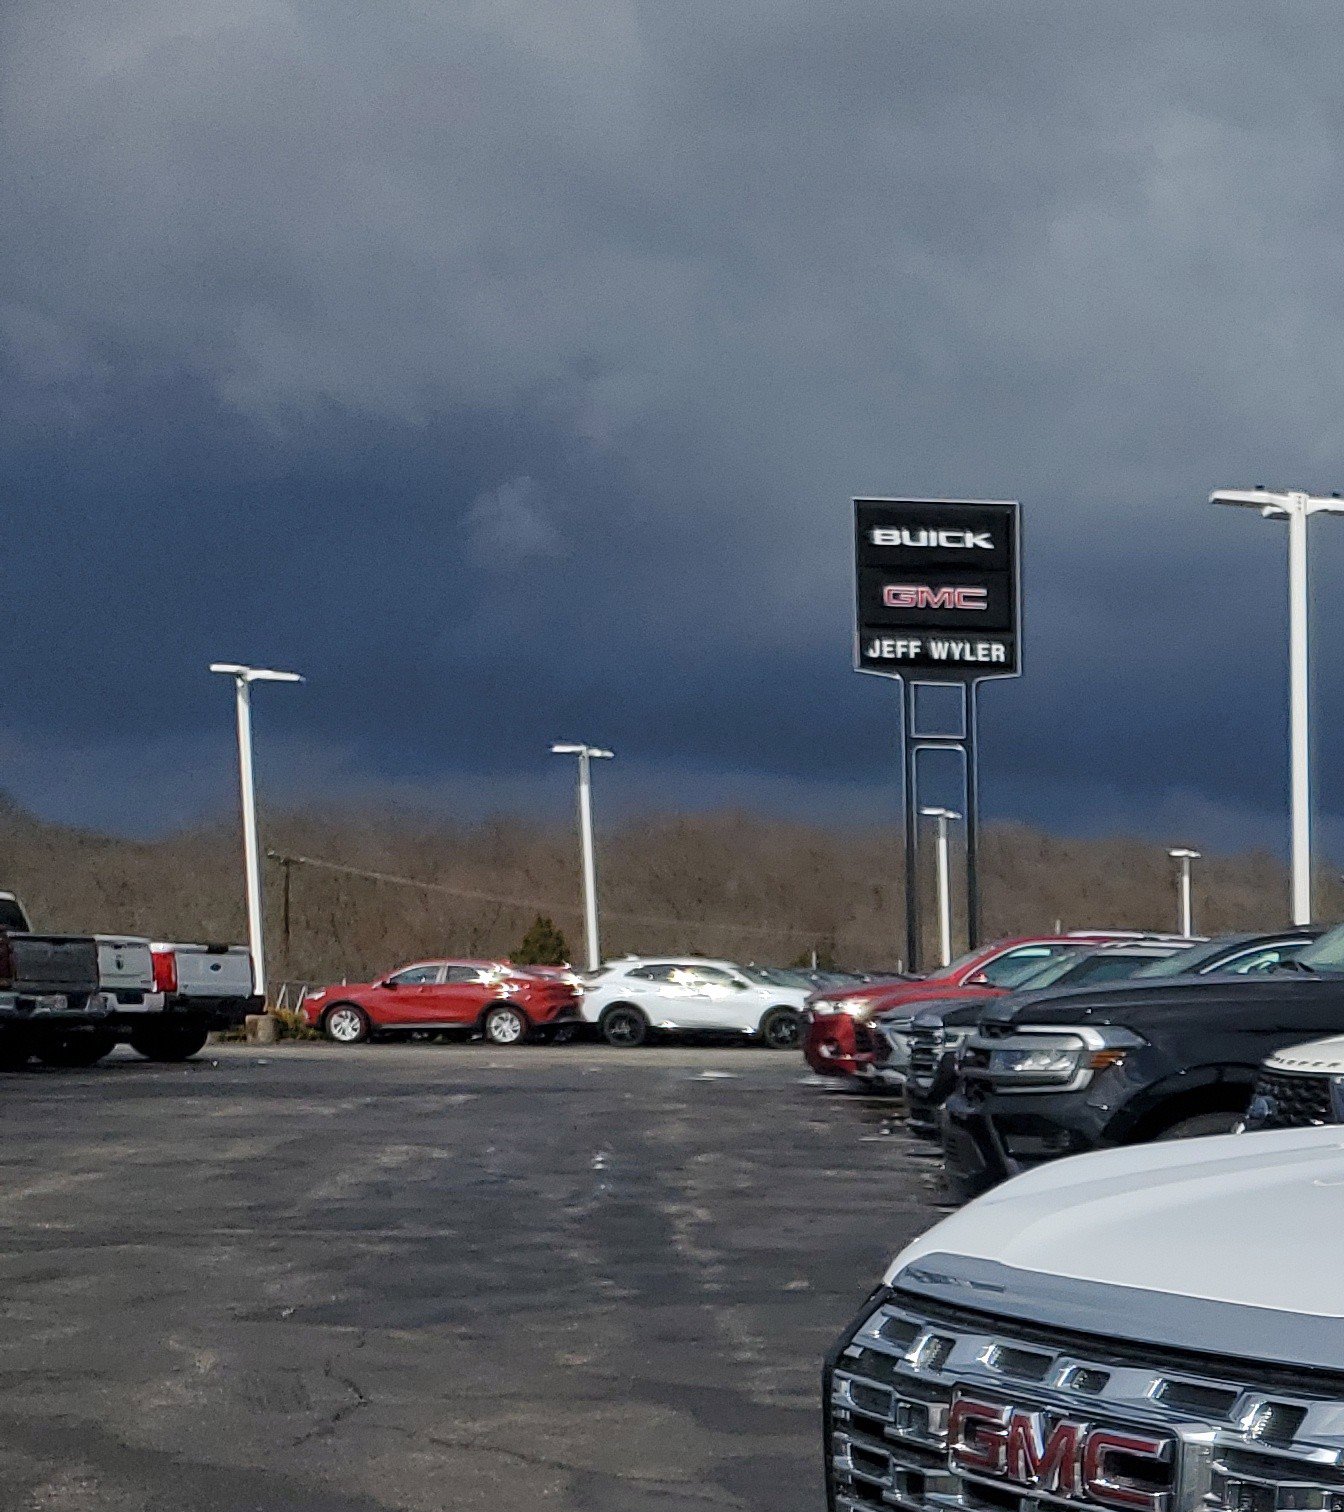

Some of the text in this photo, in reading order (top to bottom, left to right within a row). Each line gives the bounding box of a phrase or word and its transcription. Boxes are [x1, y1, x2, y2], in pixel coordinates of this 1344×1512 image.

[873, 528, 995, 549] BUICK
[883, 585, 988, 610] GMC
[867, 638, 1006, 662] JEFF WYLER
